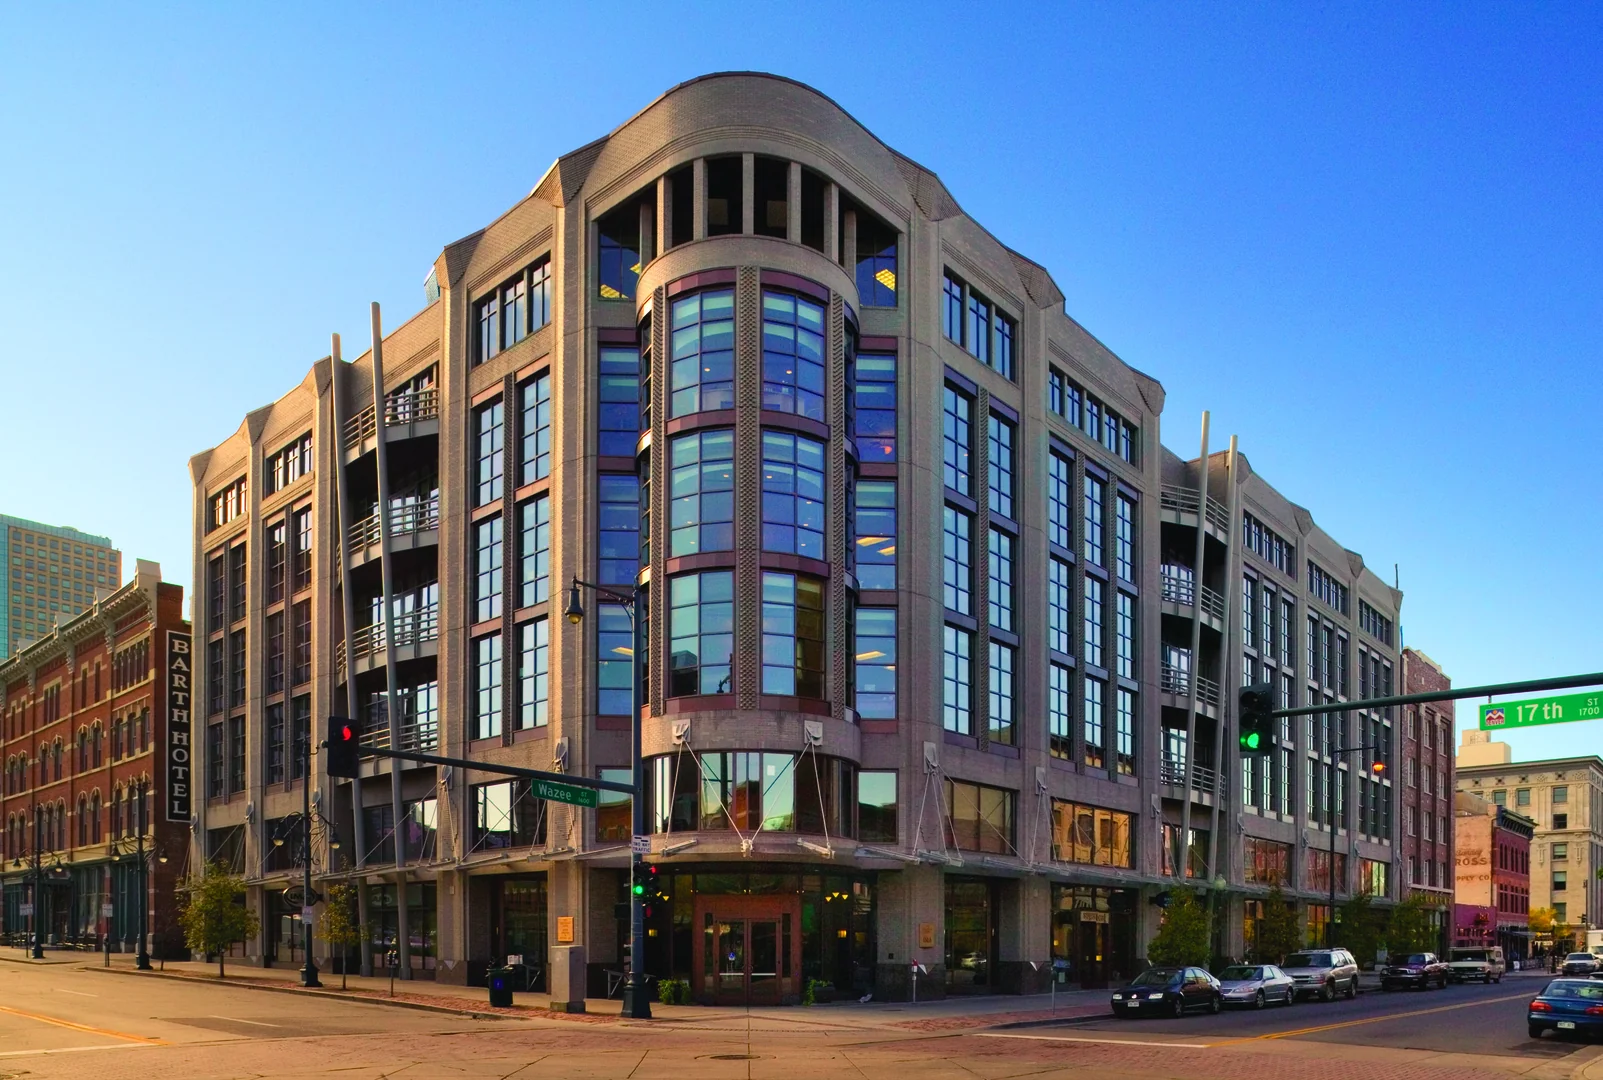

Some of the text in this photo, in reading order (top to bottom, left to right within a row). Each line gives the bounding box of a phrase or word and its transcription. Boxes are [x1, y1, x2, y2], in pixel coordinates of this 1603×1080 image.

[1587, 698, 1599, 706] ST
[1516, 702, 1563, 722] 17th
[1579, 706, 1600, 716] 1700
[171, 639, 190, 814] BARTH HOTEL
[538, 783, 572, 801] Wazee
[578, 797, 590, 805] 1600
